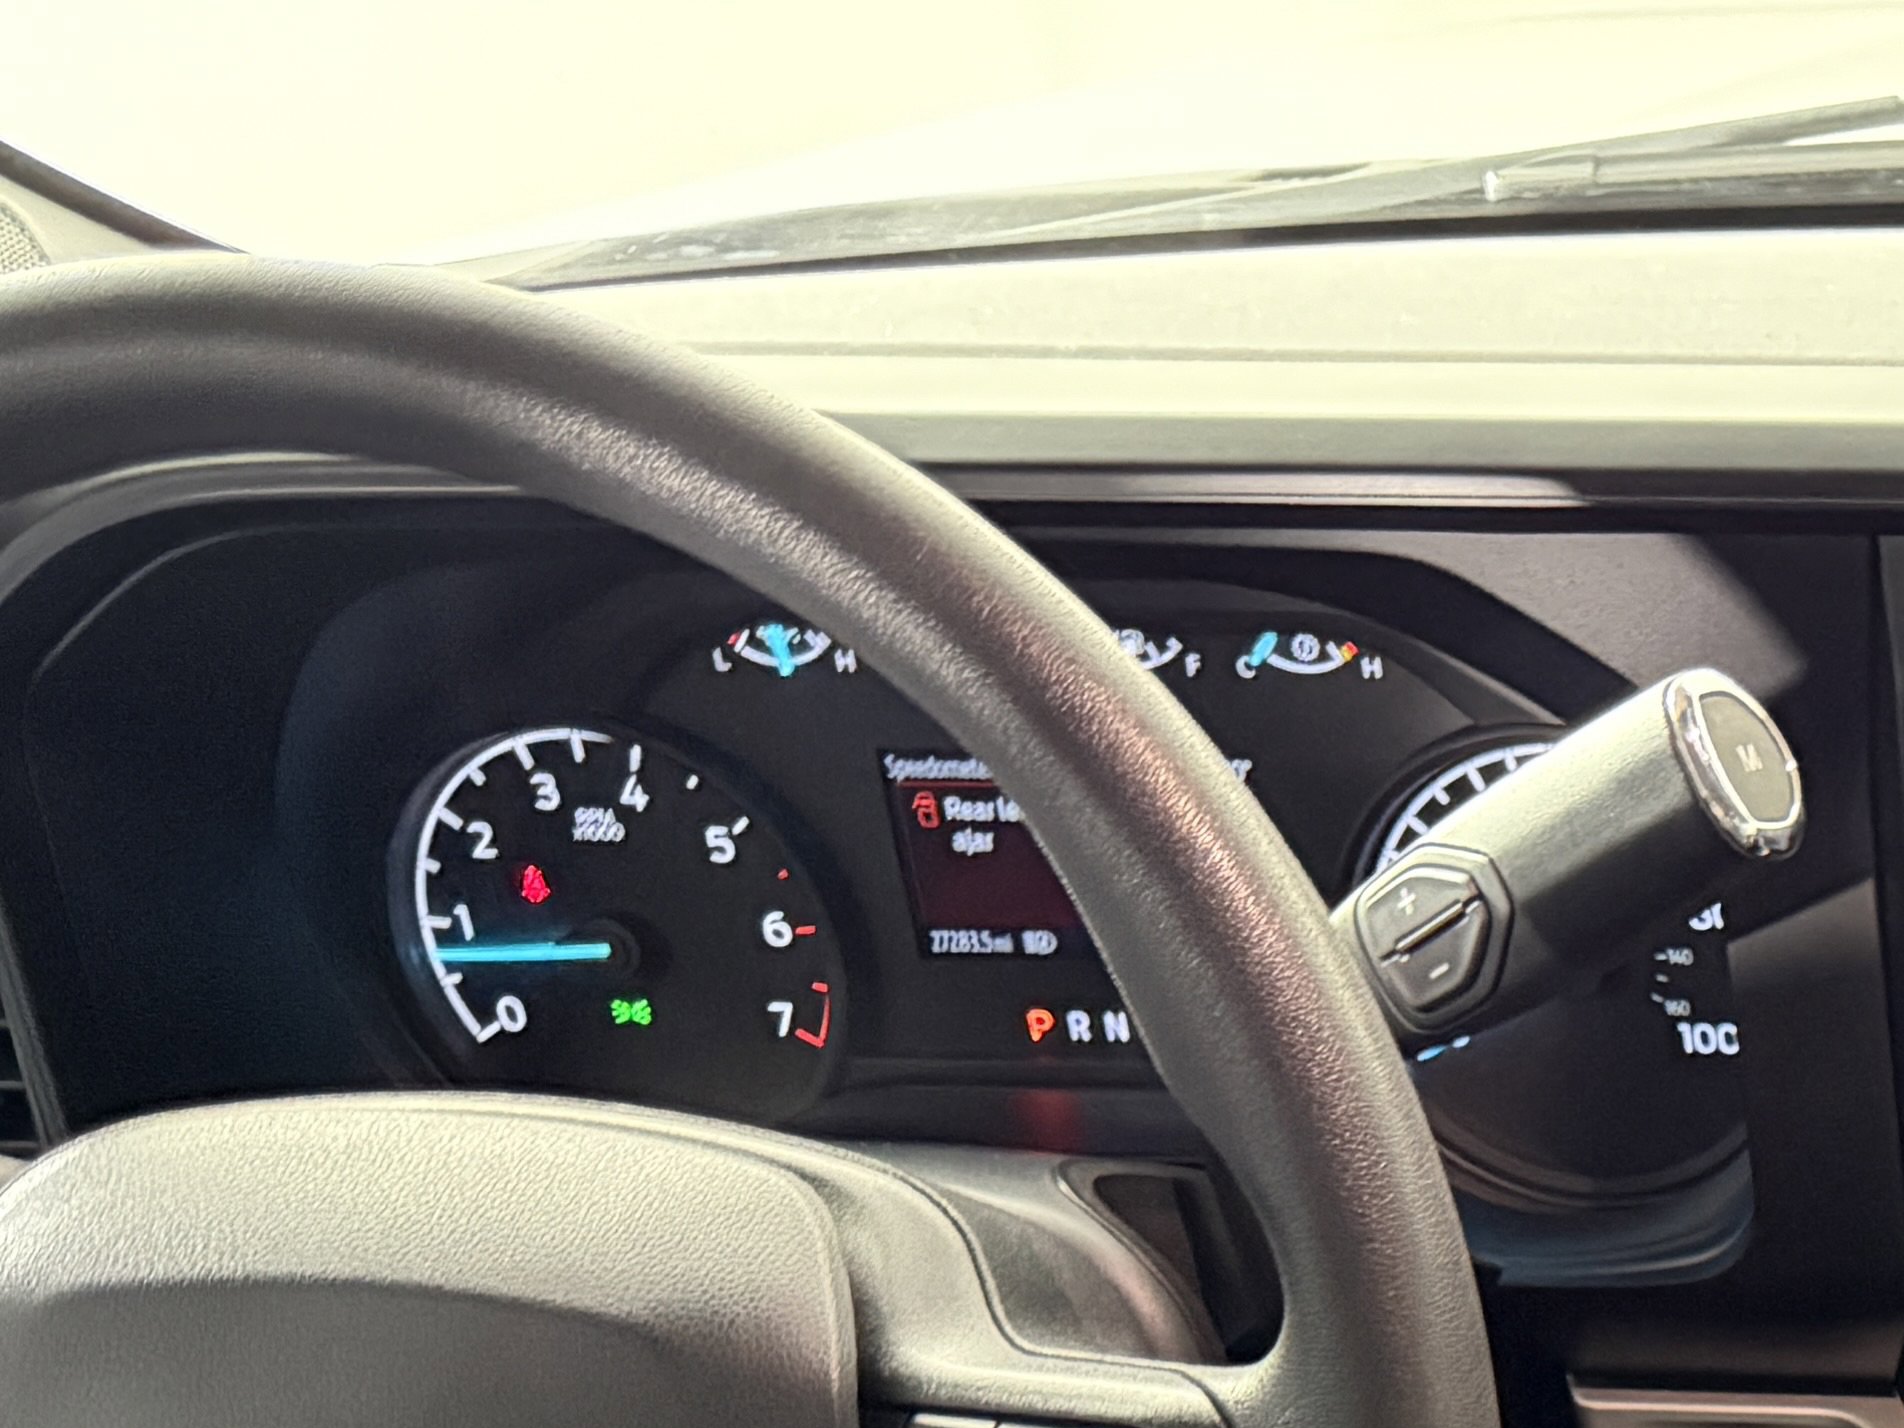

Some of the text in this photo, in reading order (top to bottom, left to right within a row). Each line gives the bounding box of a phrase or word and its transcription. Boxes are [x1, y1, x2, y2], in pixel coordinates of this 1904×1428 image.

[711, 646, 733, 672] L
[834, 648, 857, 674] H
[1184, 653, 1201, 678] F
[1360, 656, 1384, 679] H
[1735, 743, 1763, 772] M
[529, 771, 562, 811] 3
[619, 773, 651, 812] 4
[466, 821, 500, 860] 2
[704, 825, 737, 863] 5
[453, 903, 475, 940] 1
[761, 910, 794, 948] 6
[496, 995, 528, 1033] 0
[767, 1000, 794, 1037] 7
[1025, 1008, 1130, 1043] P R N
